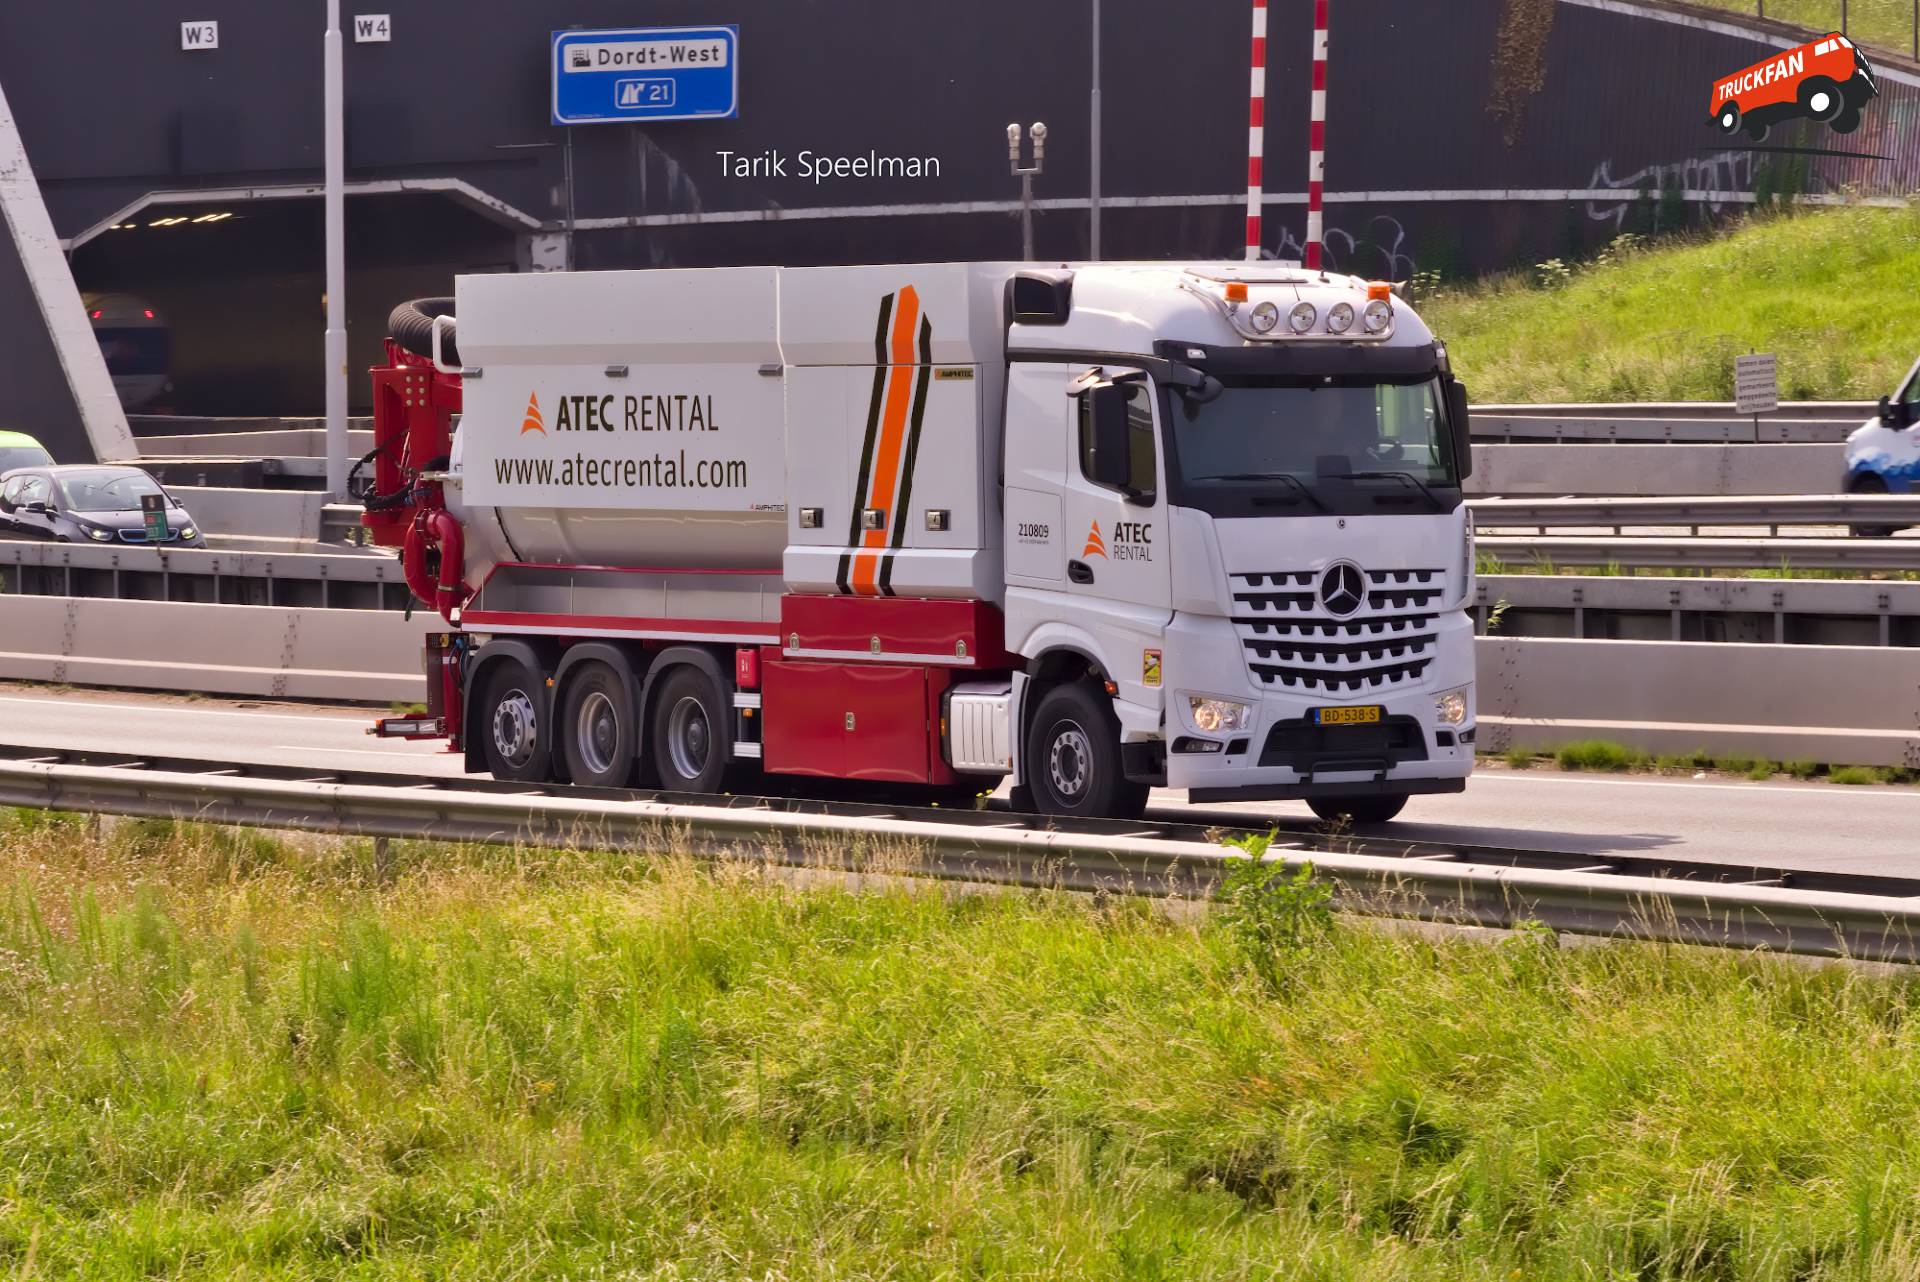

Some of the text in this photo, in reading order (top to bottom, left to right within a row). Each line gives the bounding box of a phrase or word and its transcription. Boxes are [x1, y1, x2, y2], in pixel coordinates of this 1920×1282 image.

[598, 45, 720, 65] Dordt-West
[649, 84, 669, 101] 21
[556, 394, 719, 432] ATEC RENTAL
[494, 449, 748, 488] www.atecrental.com
[1018, 523, 1049, 538] 210809
[1114, 522, 1152, 543] ATEC
[1113, 545, 1153, 561] RENTAL
